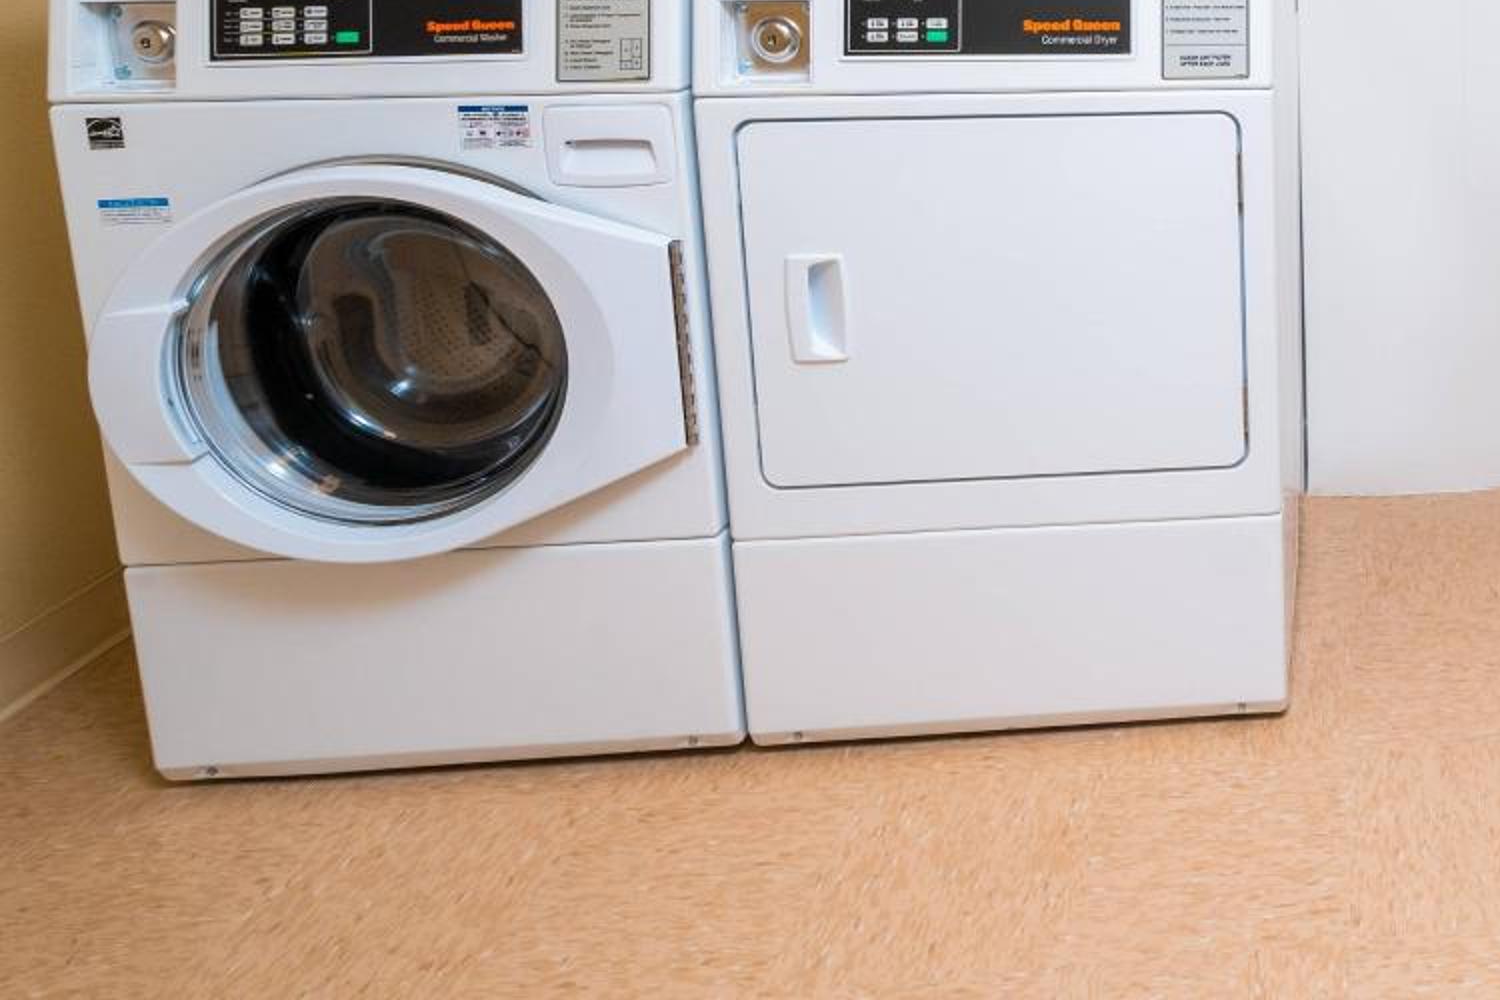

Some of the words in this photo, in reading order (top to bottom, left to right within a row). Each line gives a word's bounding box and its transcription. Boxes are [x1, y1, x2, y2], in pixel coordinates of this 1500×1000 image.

[426, 21, 469, 33] Speed
[471, 20, 515, 31] Queen
[1023, 19, 1071, 34] Speed
[1071, 19, 1121, 31] Queen
[1041, 34, 1093, 45] Commercial
[1094, 34, 1118, 45] Dryer
